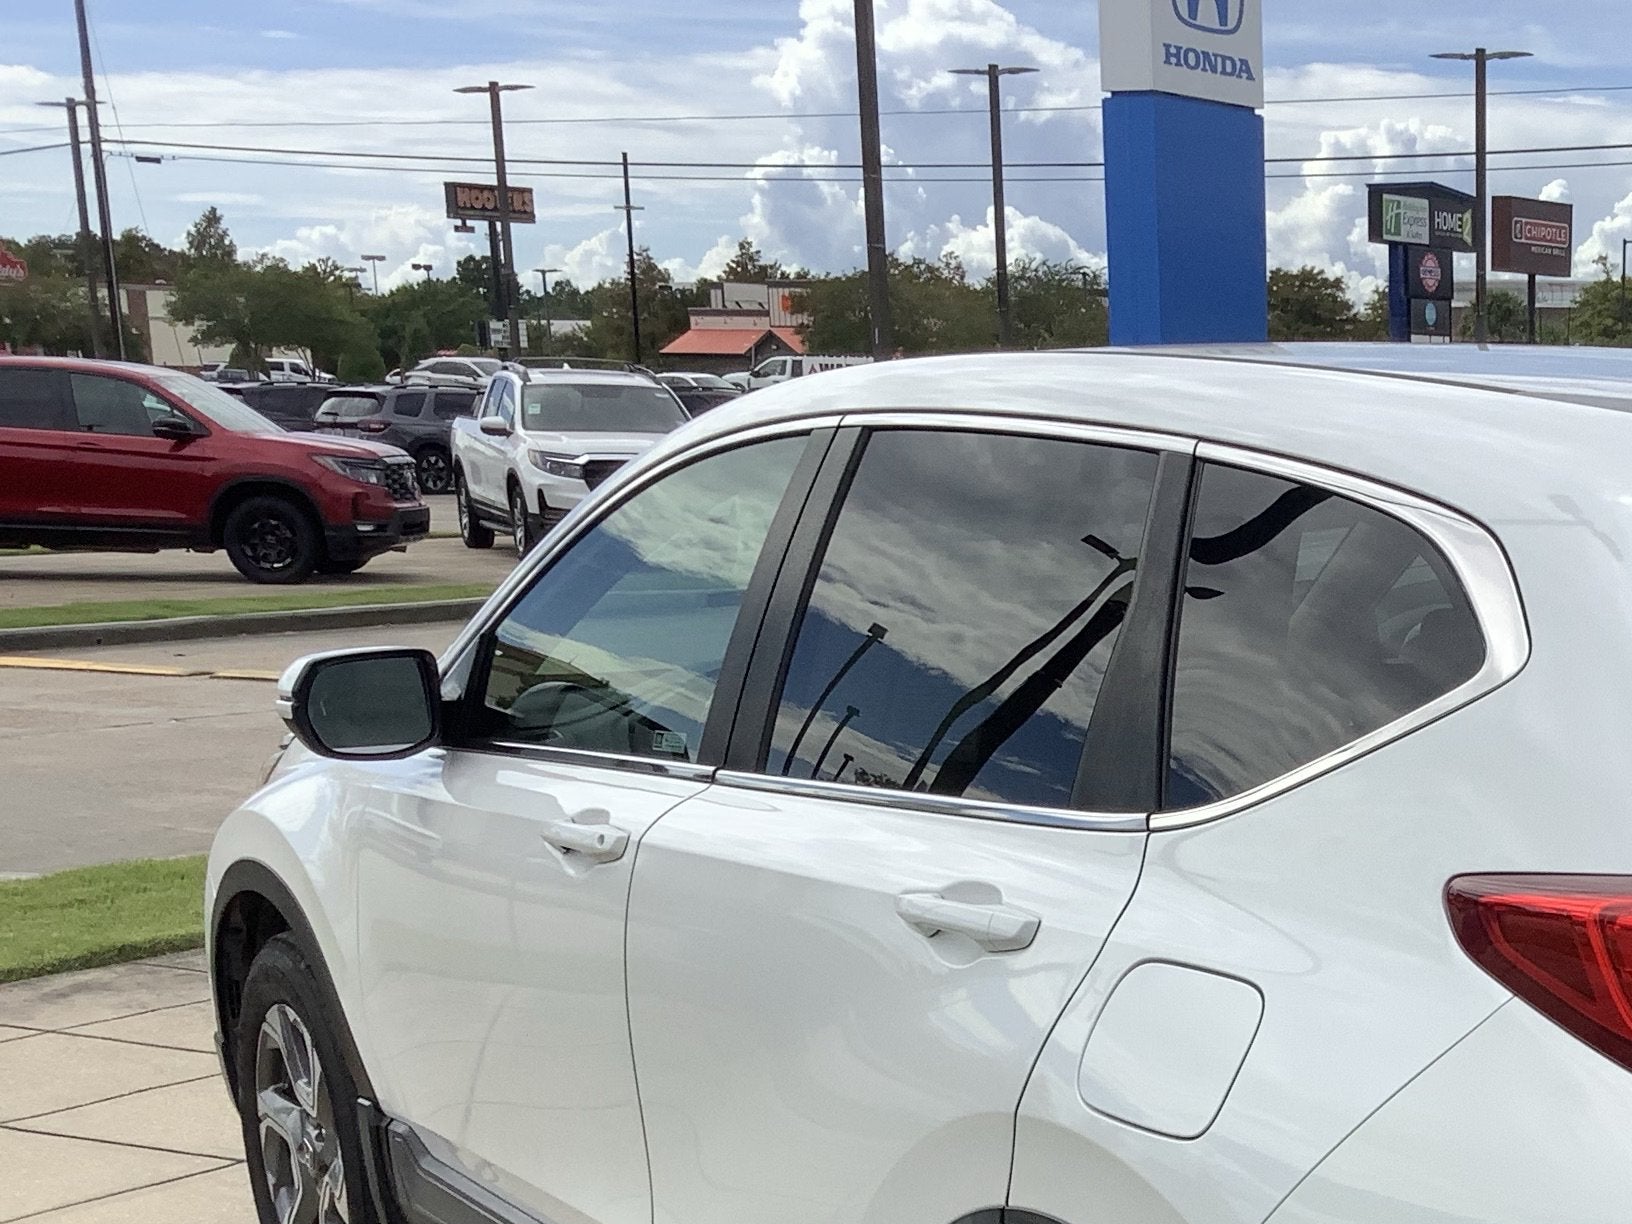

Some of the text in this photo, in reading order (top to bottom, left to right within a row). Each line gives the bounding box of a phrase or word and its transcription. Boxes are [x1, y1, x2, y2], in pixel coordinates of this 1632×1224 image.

[1162, 42, 1256, 82] HONDA
[456, 186, 533, 213] HOORS
[1525, 225, 1566, 241] CHIPOTLE
